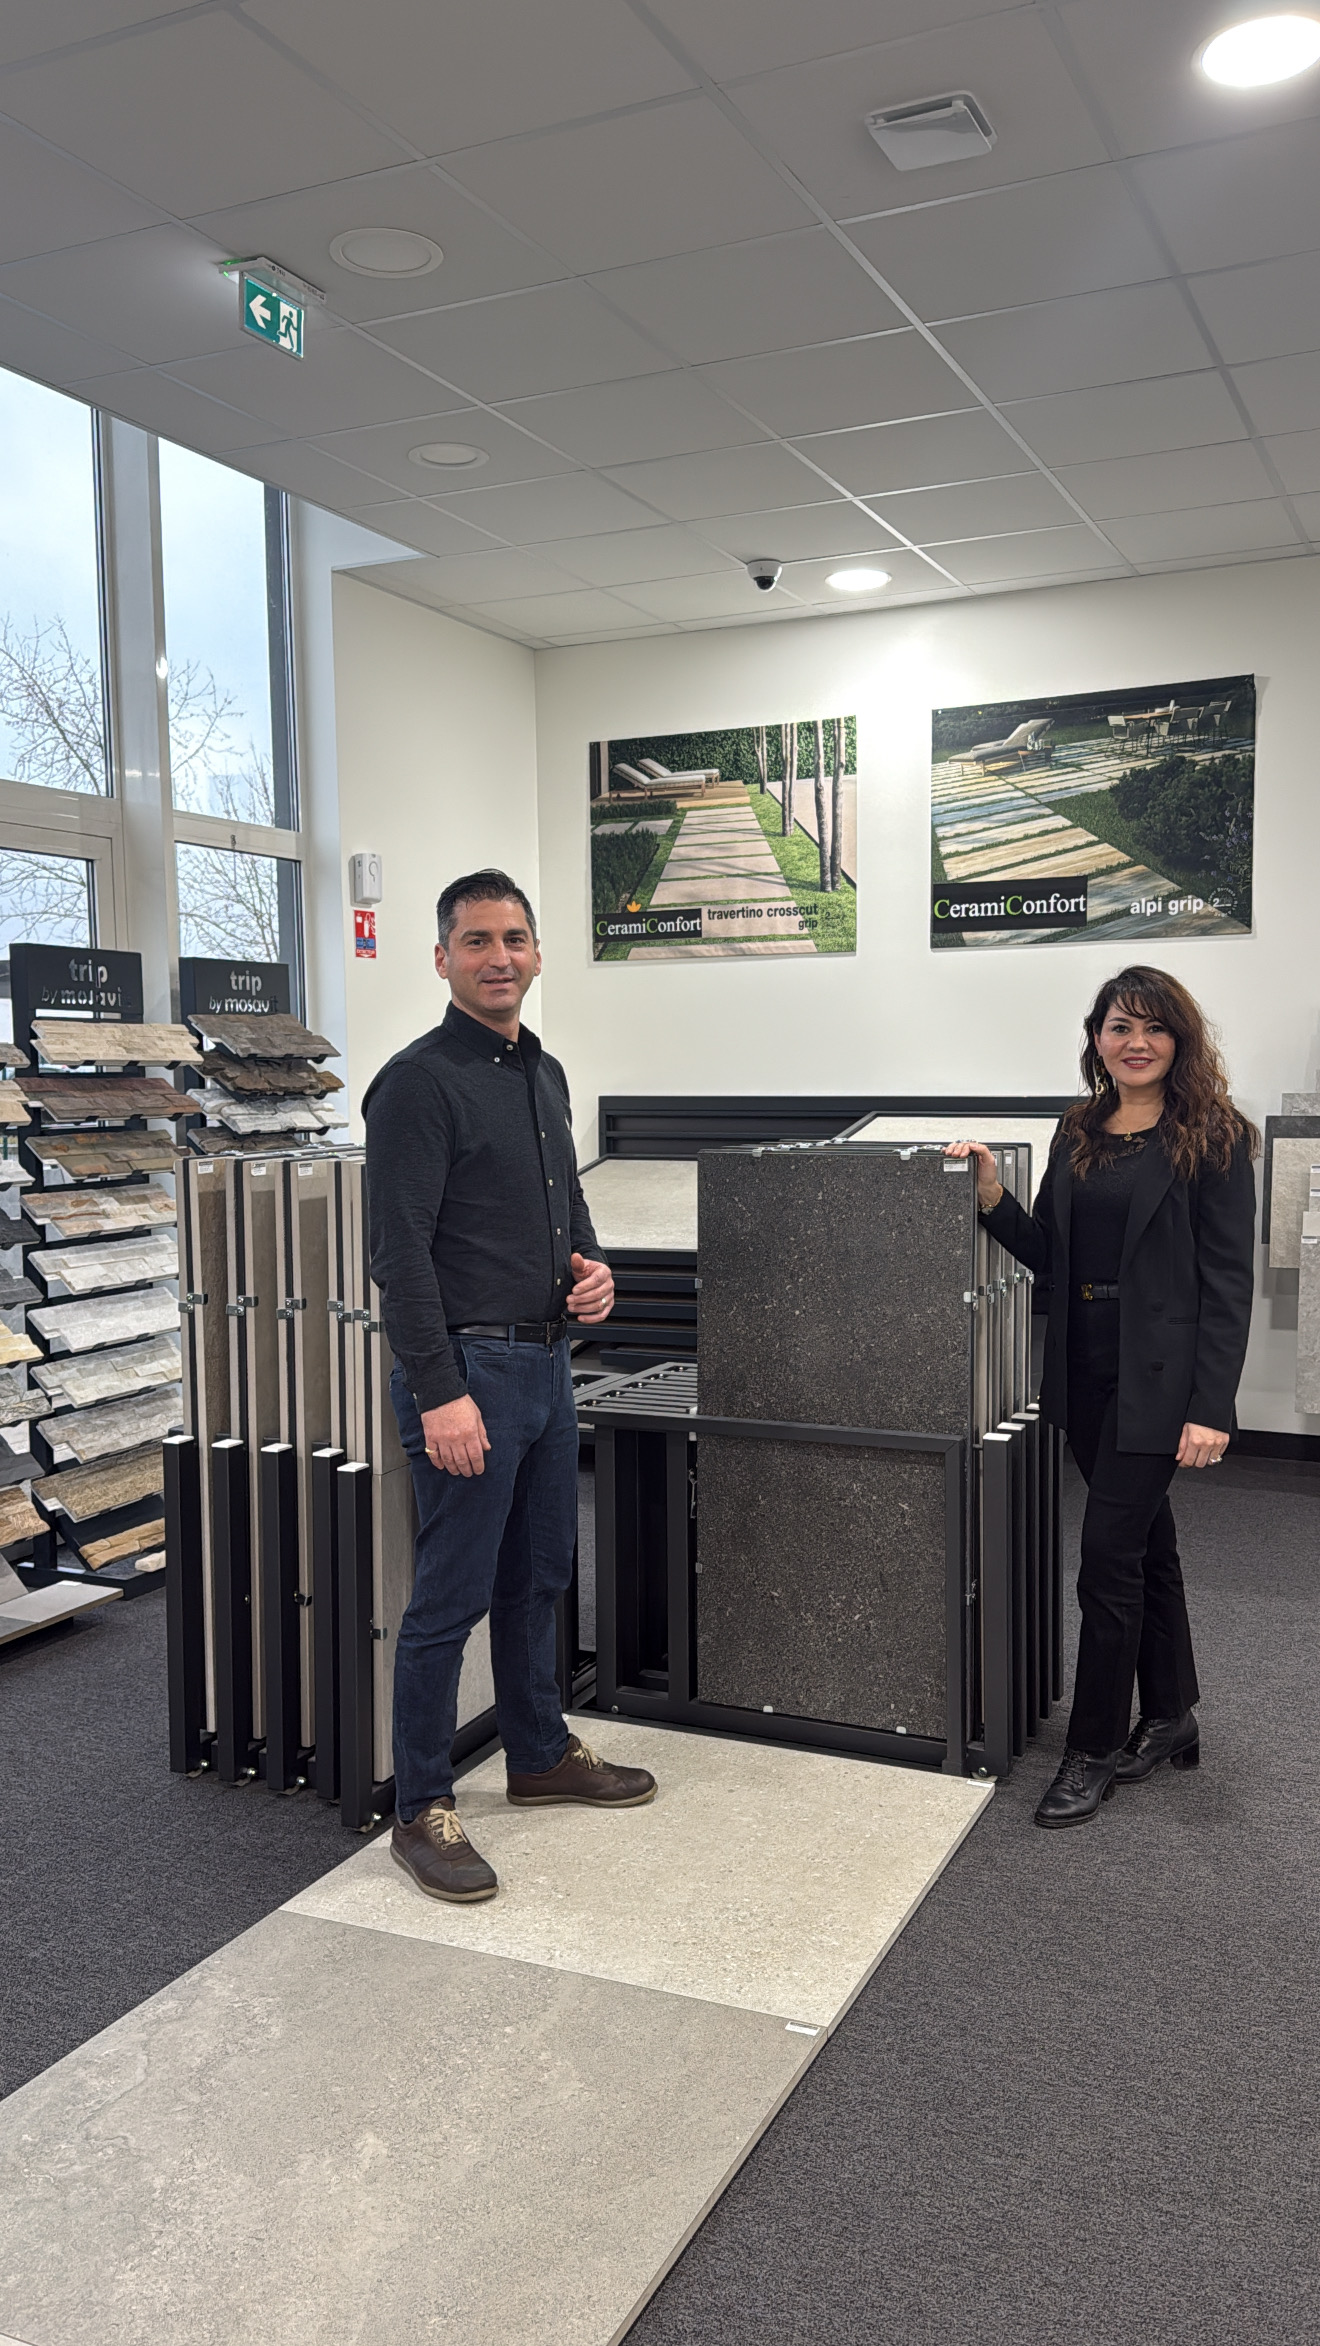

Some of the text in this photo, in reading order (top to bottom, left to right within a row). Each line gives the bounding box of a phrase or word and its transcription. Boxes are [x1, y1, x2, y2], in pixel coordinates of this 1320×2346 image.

[706, 905, 764, 921] travertino
[766, 903, 819, 918] crosscut
[933, 892, 1087, 919] CeramiConfort
[1129, 897, 1163, 917] alpi
[1167, 894, 1205, 916] grip
[595, 915, 702, 937] CeramiConfort
[798, 917, 819, 931] grip
[68, 958, 109, 989] trip
[229, 969, 263, 996] trip
[41, 986, 132, 1008] by moavi
[208, 995, 222, 1014] by
